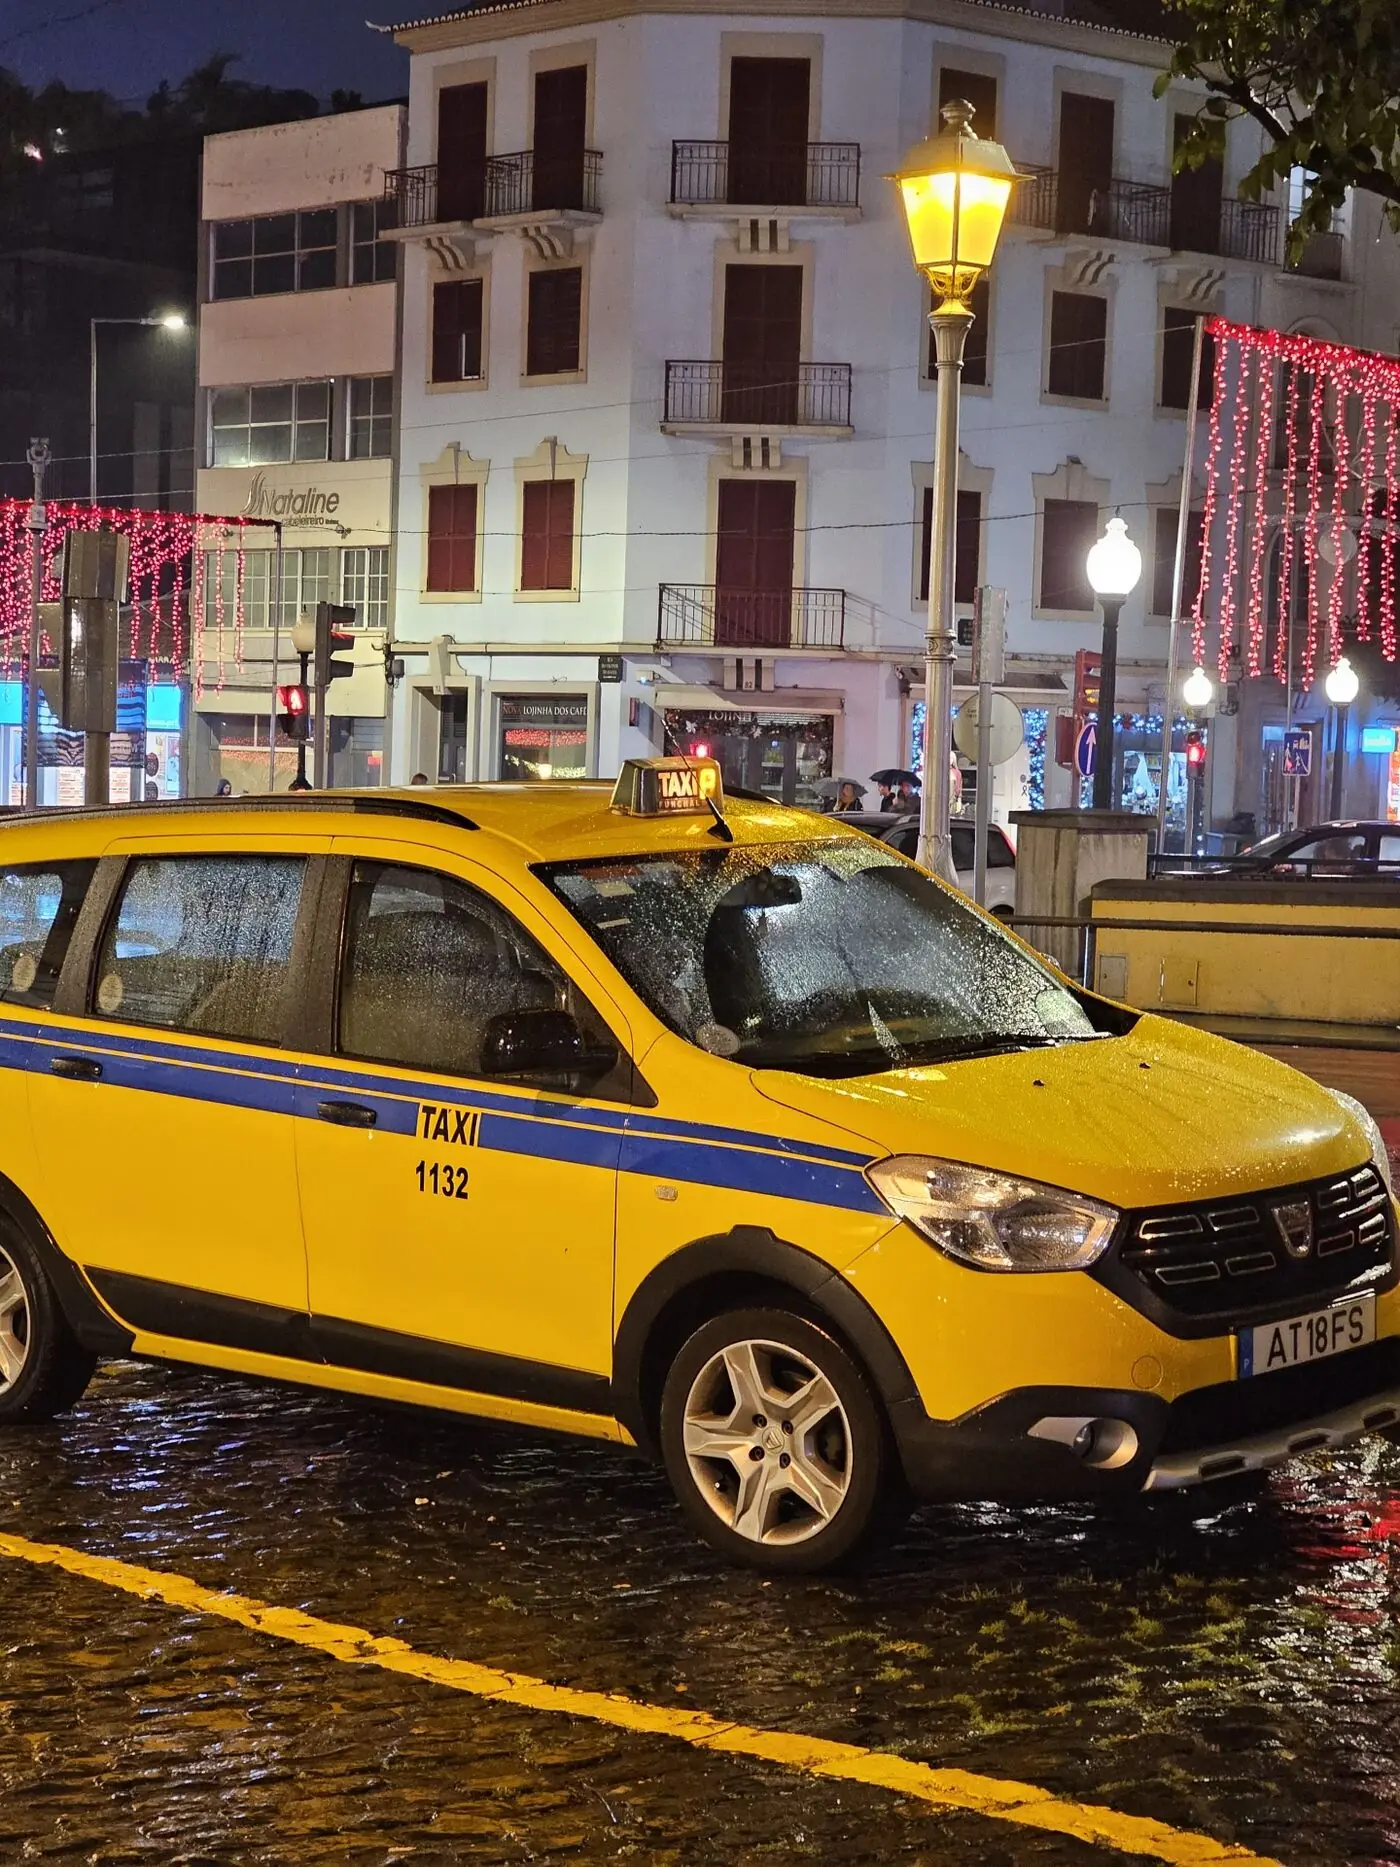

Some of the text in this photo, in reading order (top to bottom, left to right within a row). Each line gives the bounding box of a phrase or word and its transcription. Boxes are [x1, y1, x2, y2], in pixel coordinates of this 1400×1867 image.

[257, 487, 340, 515] Nataline
[502, 705, 521, 715] NOVA
[523, 705, 553, 716] LOJINHA
[554, 706, 568, 716] DOS
[657, 771, 699, 797] TAXI
[658, 799, 700, 809] FUNCHAL
[421, 1105, 479, 1147] TAXI
[415, 1160, 469, 1200] 1132
[1243, 1306, 1364, 1370] P AT18FS
